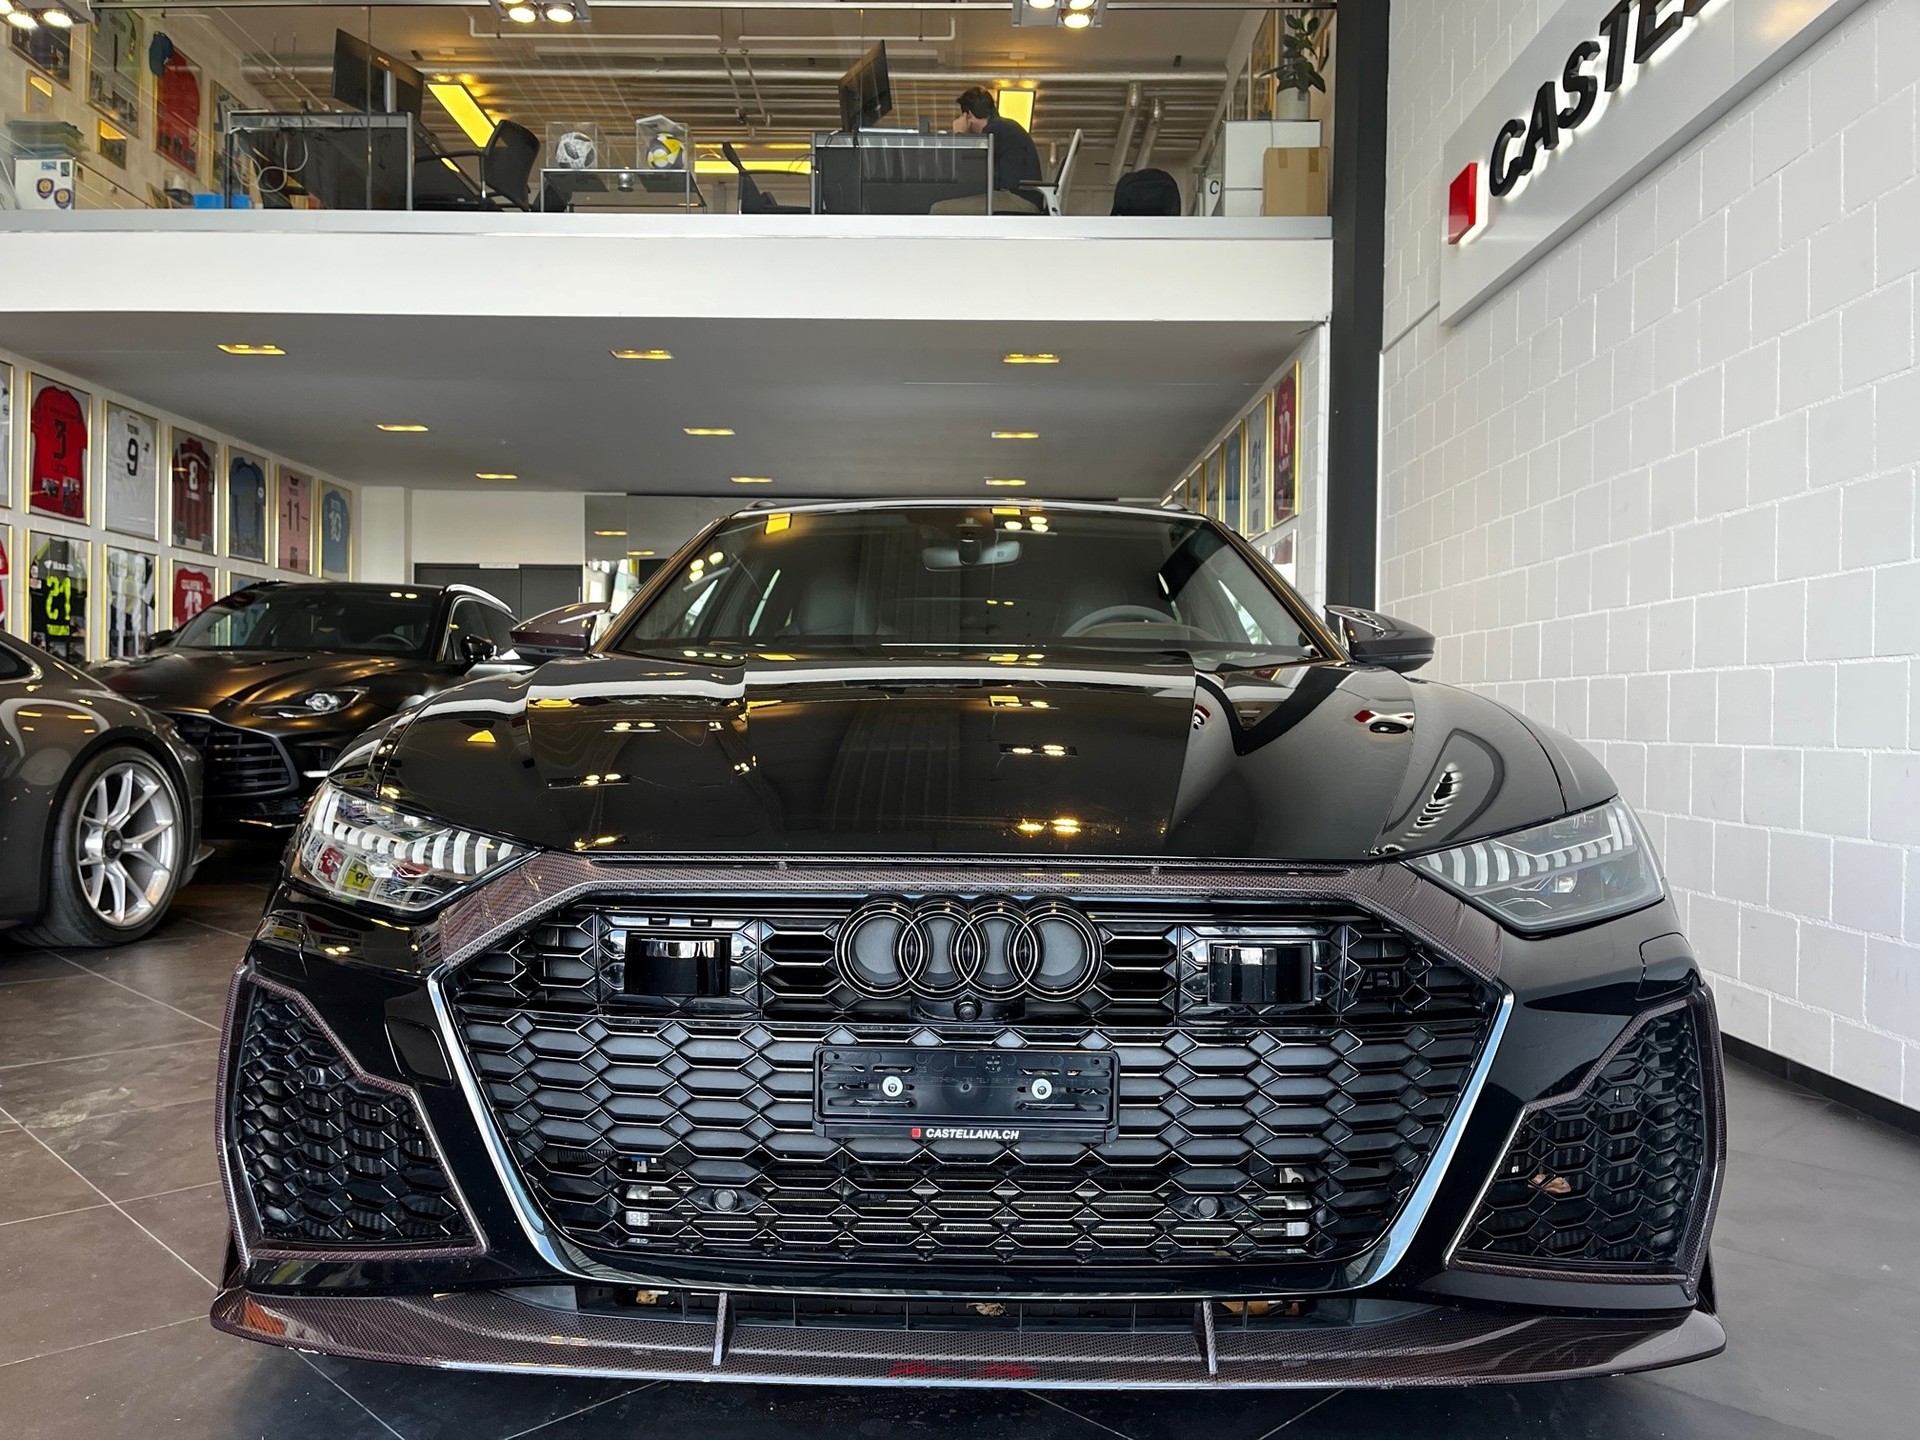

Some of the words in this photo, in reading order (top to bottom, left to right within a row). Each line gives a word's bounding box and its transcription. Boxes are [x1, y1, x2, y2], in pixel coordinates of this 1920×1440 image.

[1489, 0, 1710, 197] CASTE
[126, 438, 139, 476] 9
[188, 459, 200, 491] 8
[287, 498, 300, 532] 11
[46, 575, 72, 620] 21
[925, 1127, 1020, 1140] CASTELLANA.CH
